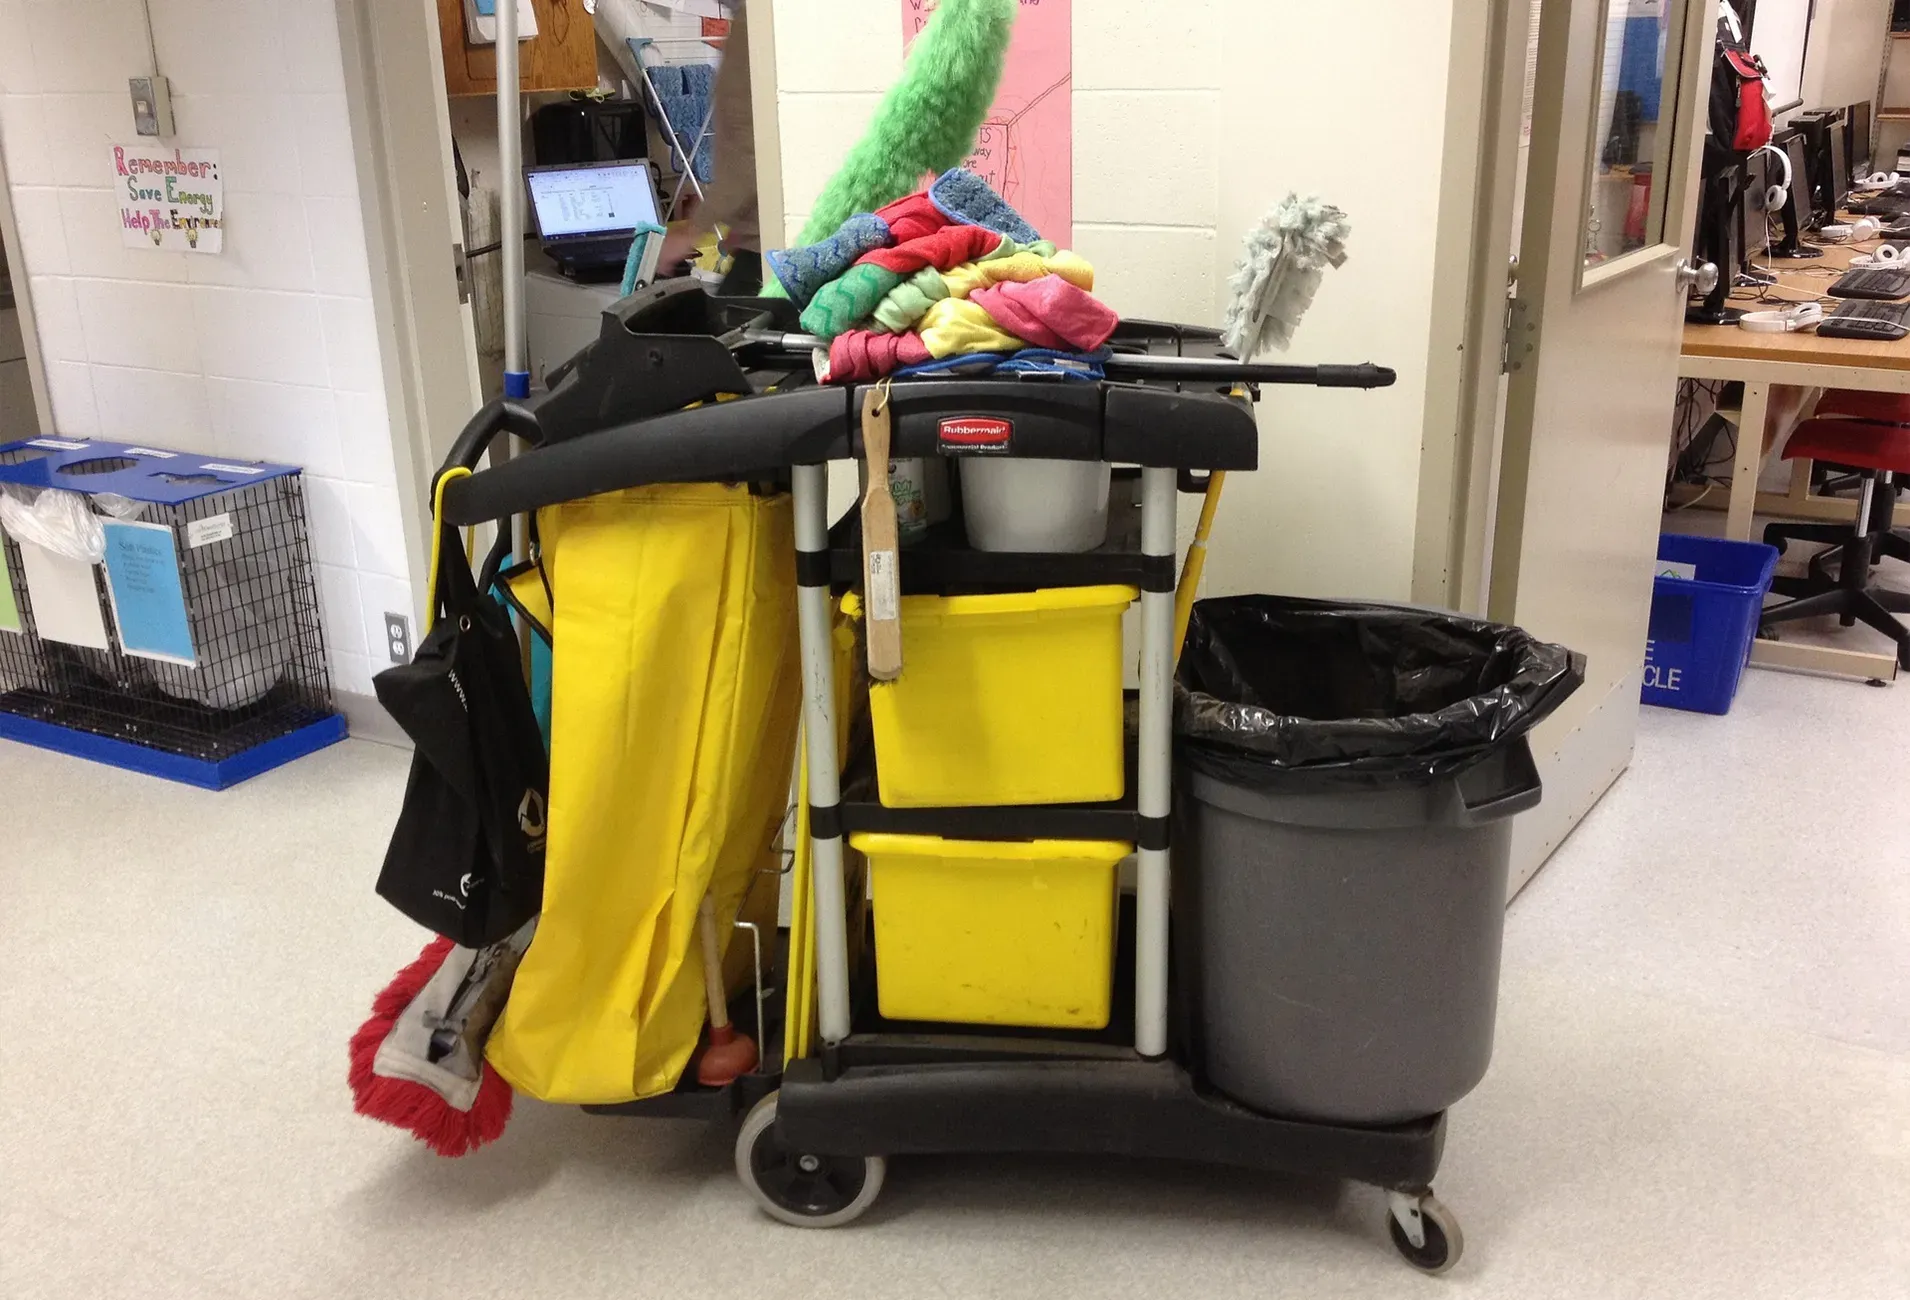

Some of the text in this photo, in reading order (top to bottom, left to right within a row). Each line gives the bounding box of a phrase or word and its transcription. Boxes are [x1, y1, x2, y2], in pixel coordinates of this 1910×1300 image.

[113, 146, 218, 180] Remember:
[127, 175, 213, 215] Save Energy
[121, 208, 150, 235] Help
[148, 209, 171, 229] The
